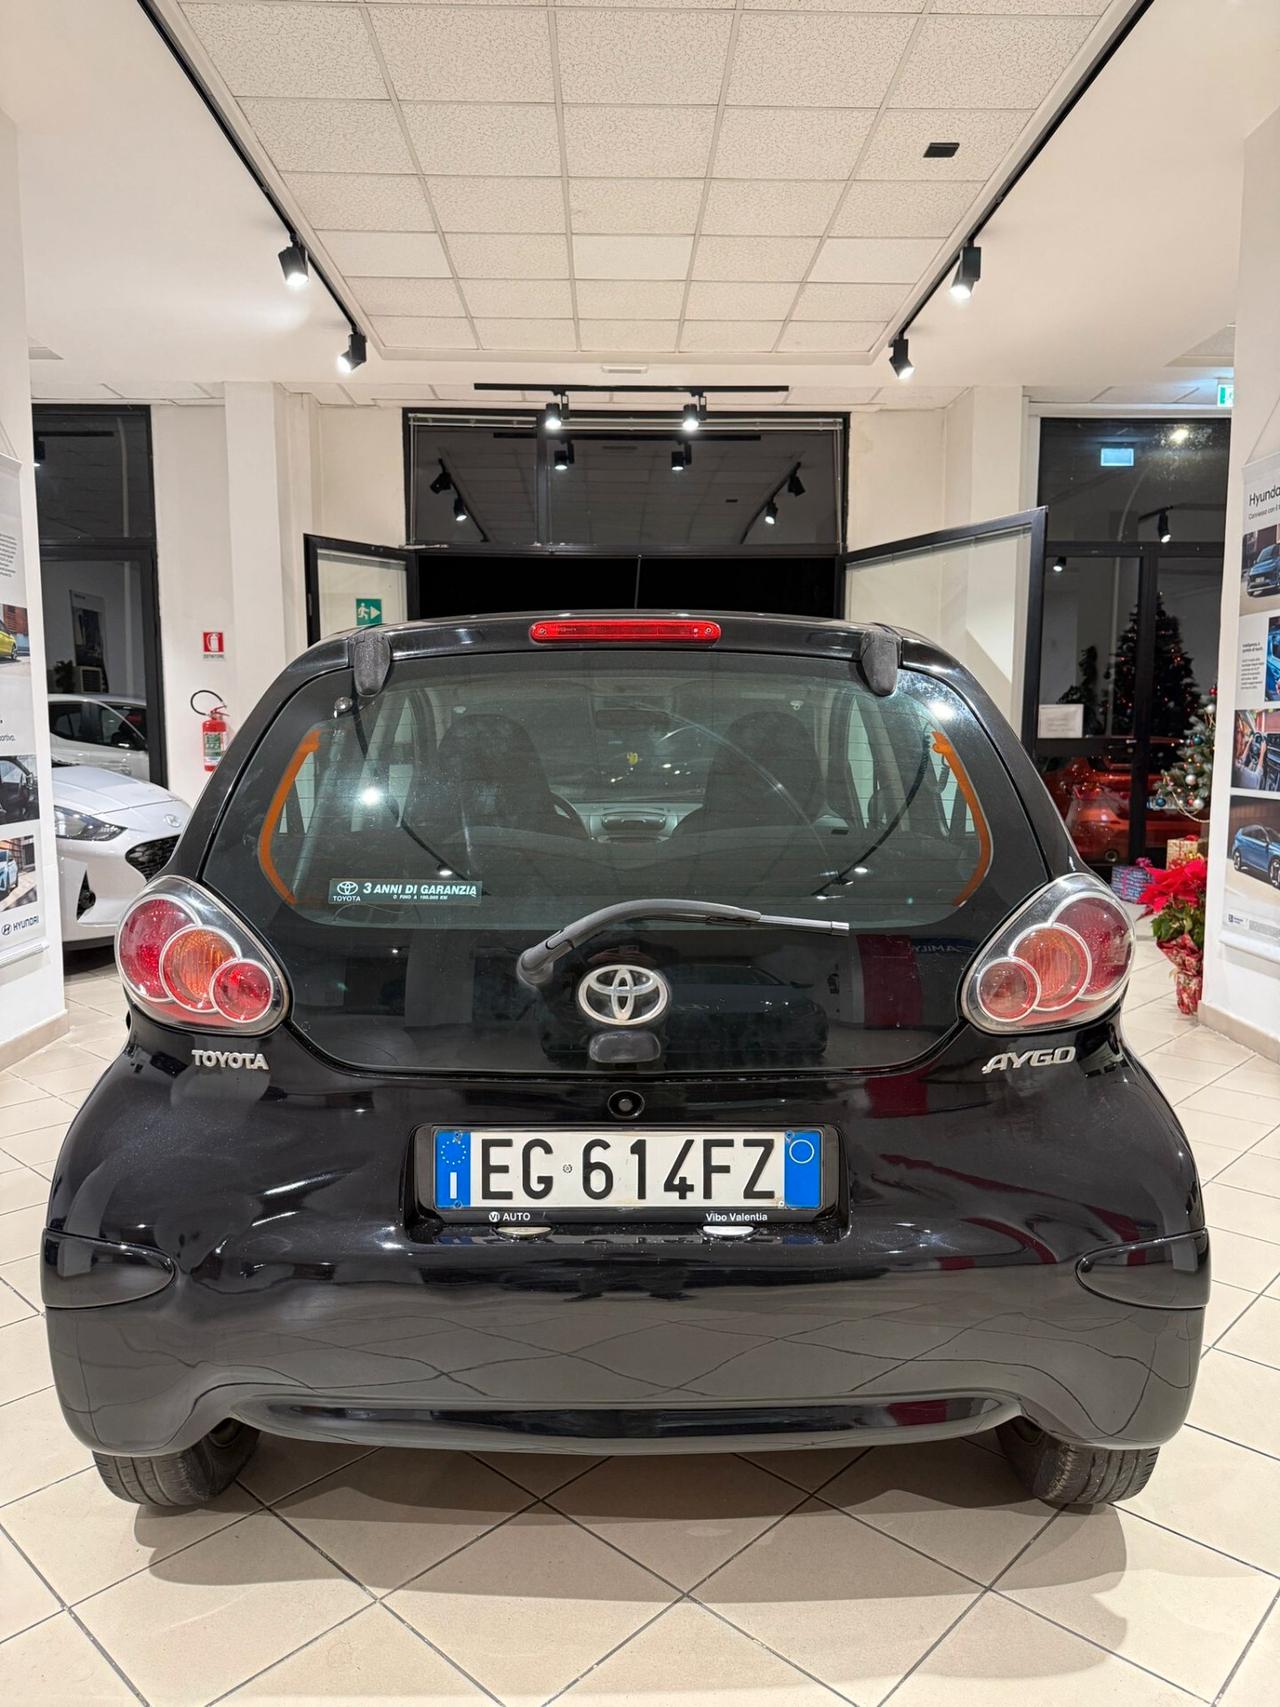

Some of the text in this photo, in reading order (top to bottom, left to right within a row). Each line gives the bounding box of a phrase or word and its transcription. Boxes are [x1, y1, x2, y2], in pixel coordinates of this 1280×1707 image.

[363, 882, 477, 897] 3 ANNI DI GARANZIA
[13, 914, 40, 931] HYUNDAI
[191, 1049, 270, 1070] TOYOTA
[981, 1046, 1076, 1074] AYGO
[481, 1138, 775, 1200] EG 614FZ
[502, 1212, 531, 1221] AUTO
[705, 1211, 768, 1222] Vibo Valentia
